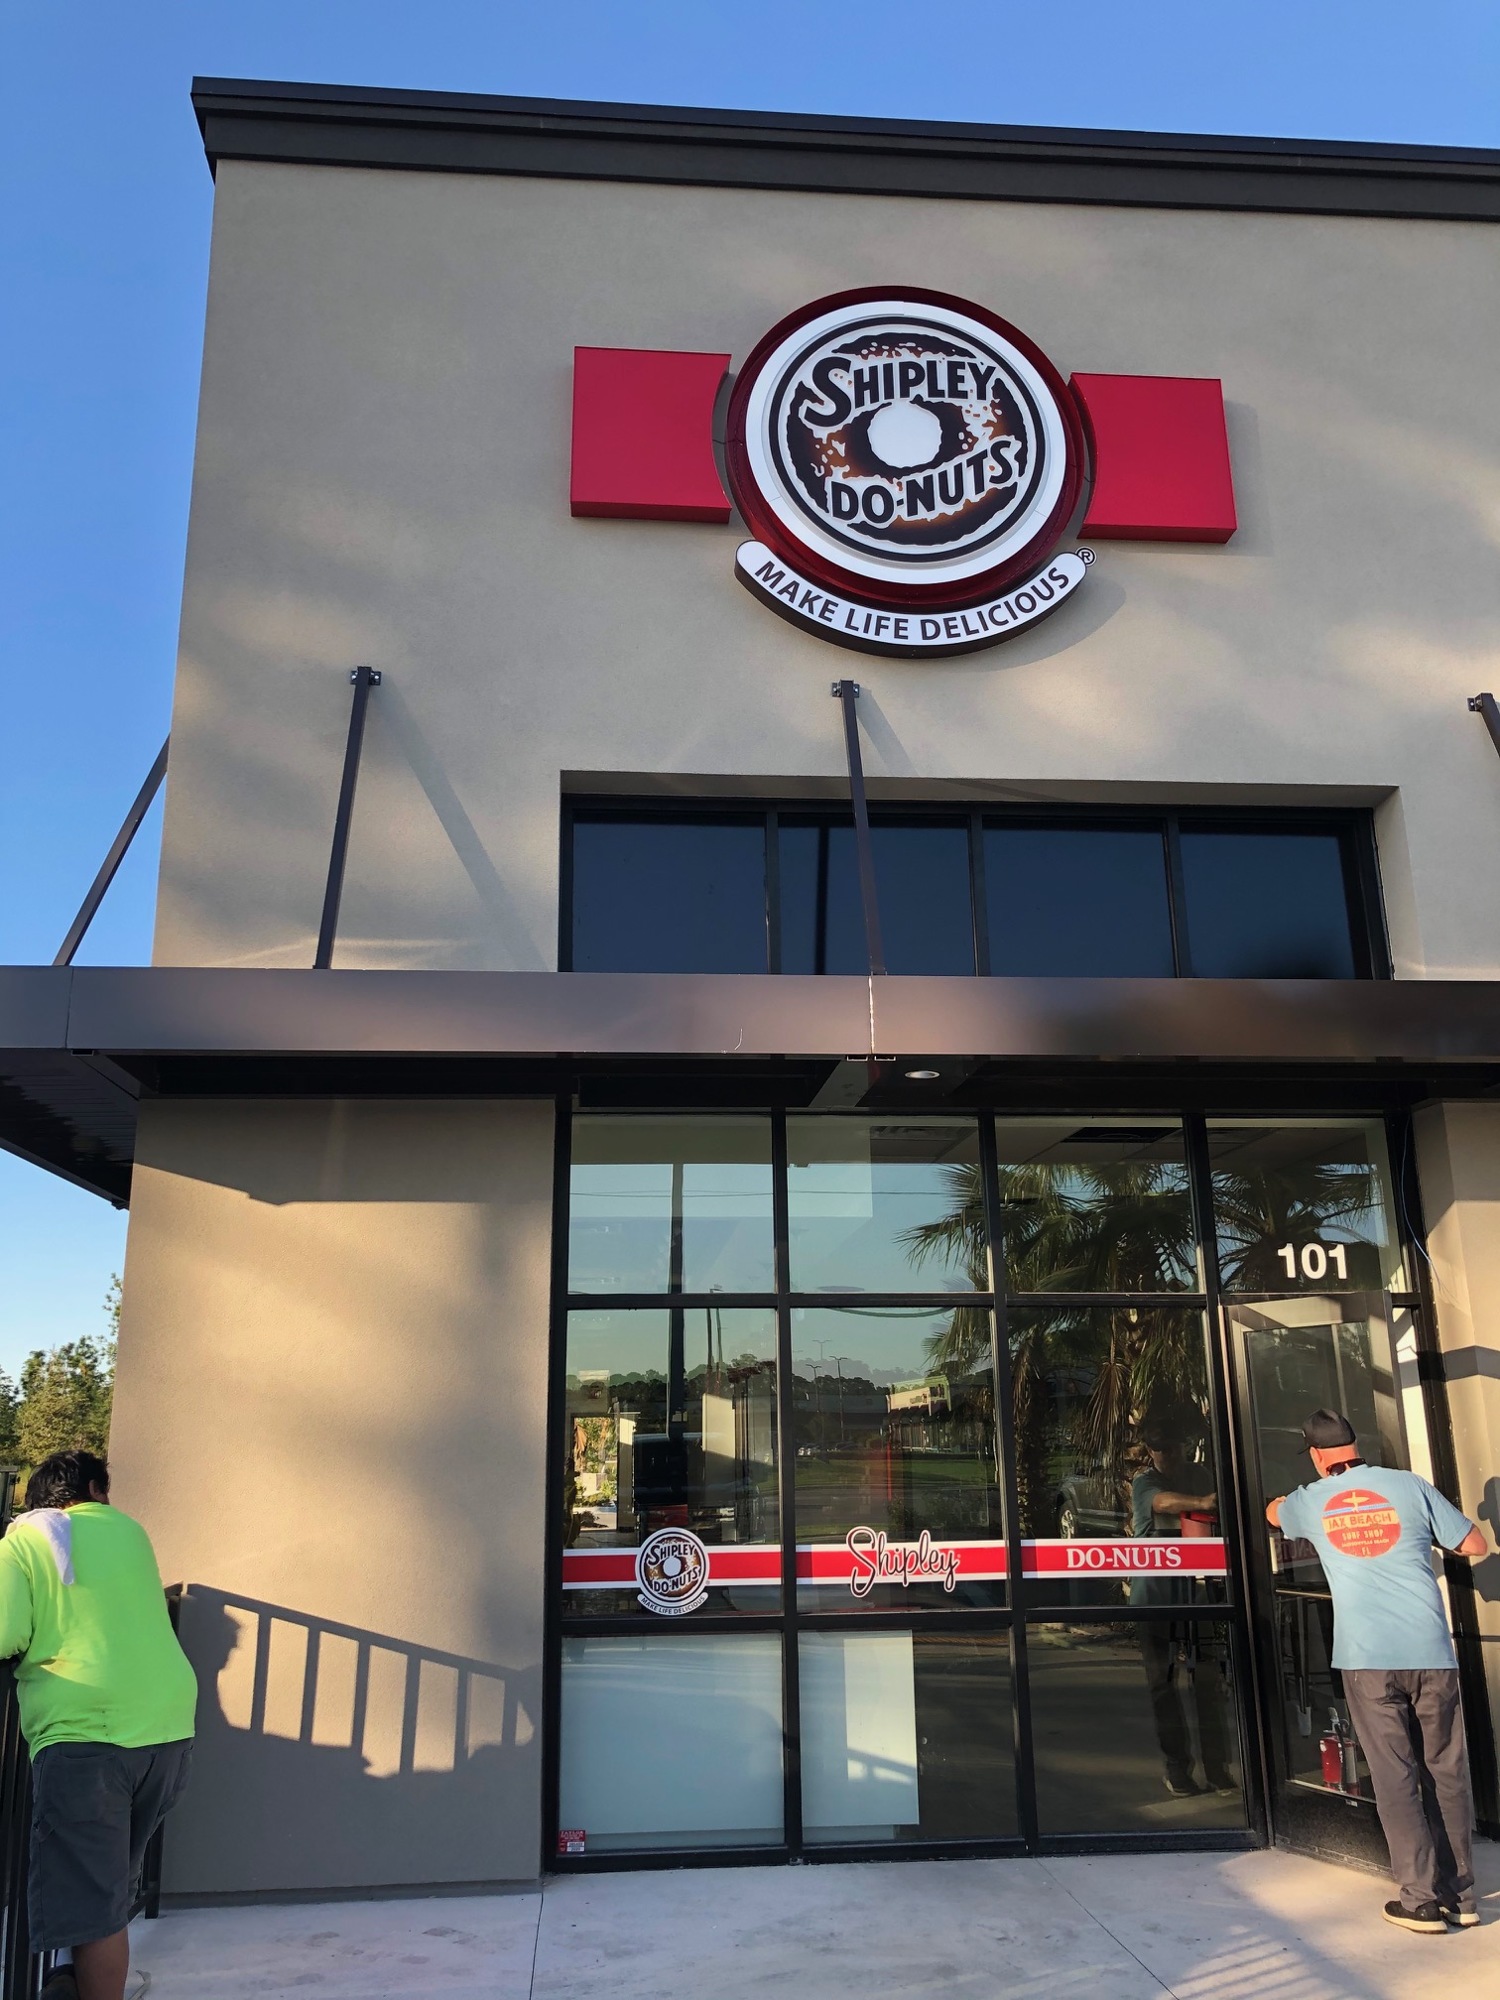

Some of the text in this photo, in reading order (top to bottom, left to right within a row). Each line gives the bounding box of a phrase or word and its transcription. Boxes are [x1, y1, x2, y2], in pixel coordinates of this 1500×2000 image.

[804, 356, 996, 428] SHIPLEY
[830, 440, 1012, 522] DO-NUTS
[755, 561, 839, 622] MAKE
[845, 611, 909, 640] LIFE
[920, 566, 1070, 642] DELICIOUS
[1278, 1243, 1347, 1279] 101
[1350, 1512, 1392, 1526] BEACH
[1341, 1529, 1384, 1541] SURF SHOP
[648, 1544, 695, 1565] SHIPLEY
[847, 1527, 959, 1597] Shipley
[1066, 1547, 1182, 1569] DO-NUTS
[653, 1567, 698, 1592] DO-NUTS
[641, 1596, 705, 1615] MAKE LIFE DELICIOUS
